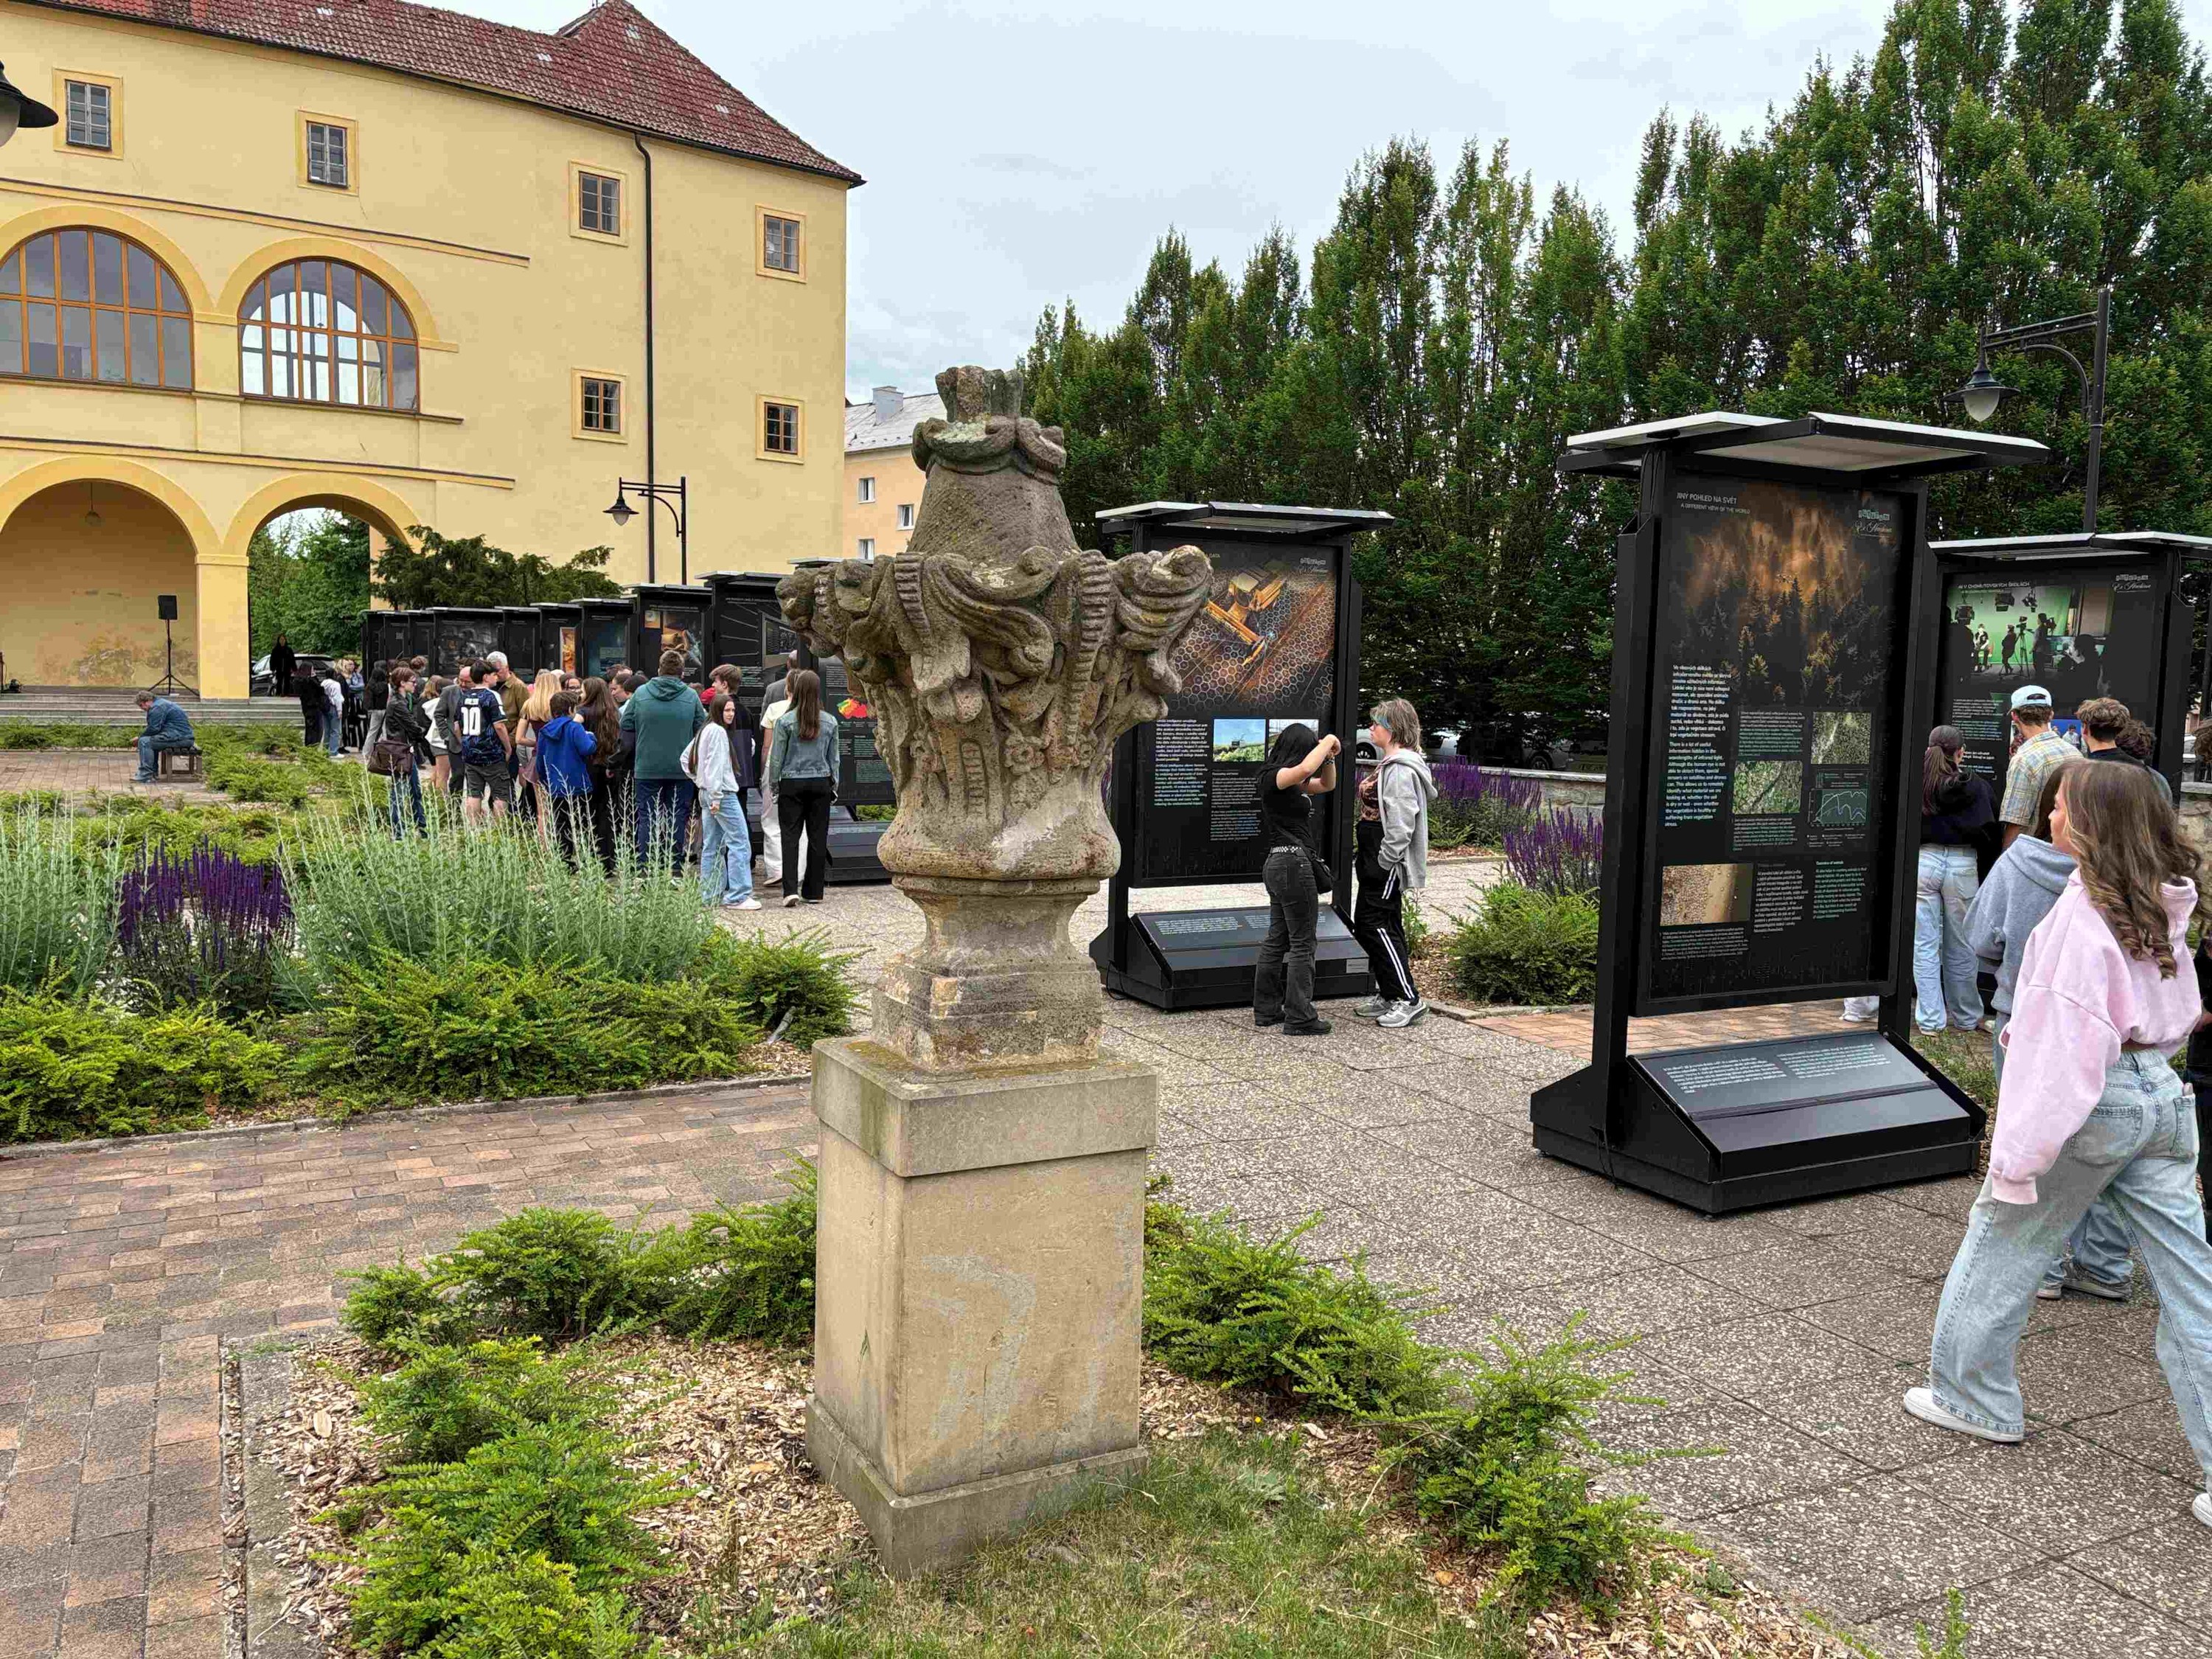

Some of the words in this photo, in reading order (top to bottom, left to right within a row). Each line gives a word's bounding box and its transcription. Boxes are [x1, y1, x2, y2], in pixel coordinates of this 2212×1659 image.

[1690, 493, 1712, 501] POHLED
[1722, 495, 1736, 504] SVĚT
[461, 706, 481, 737] 10
